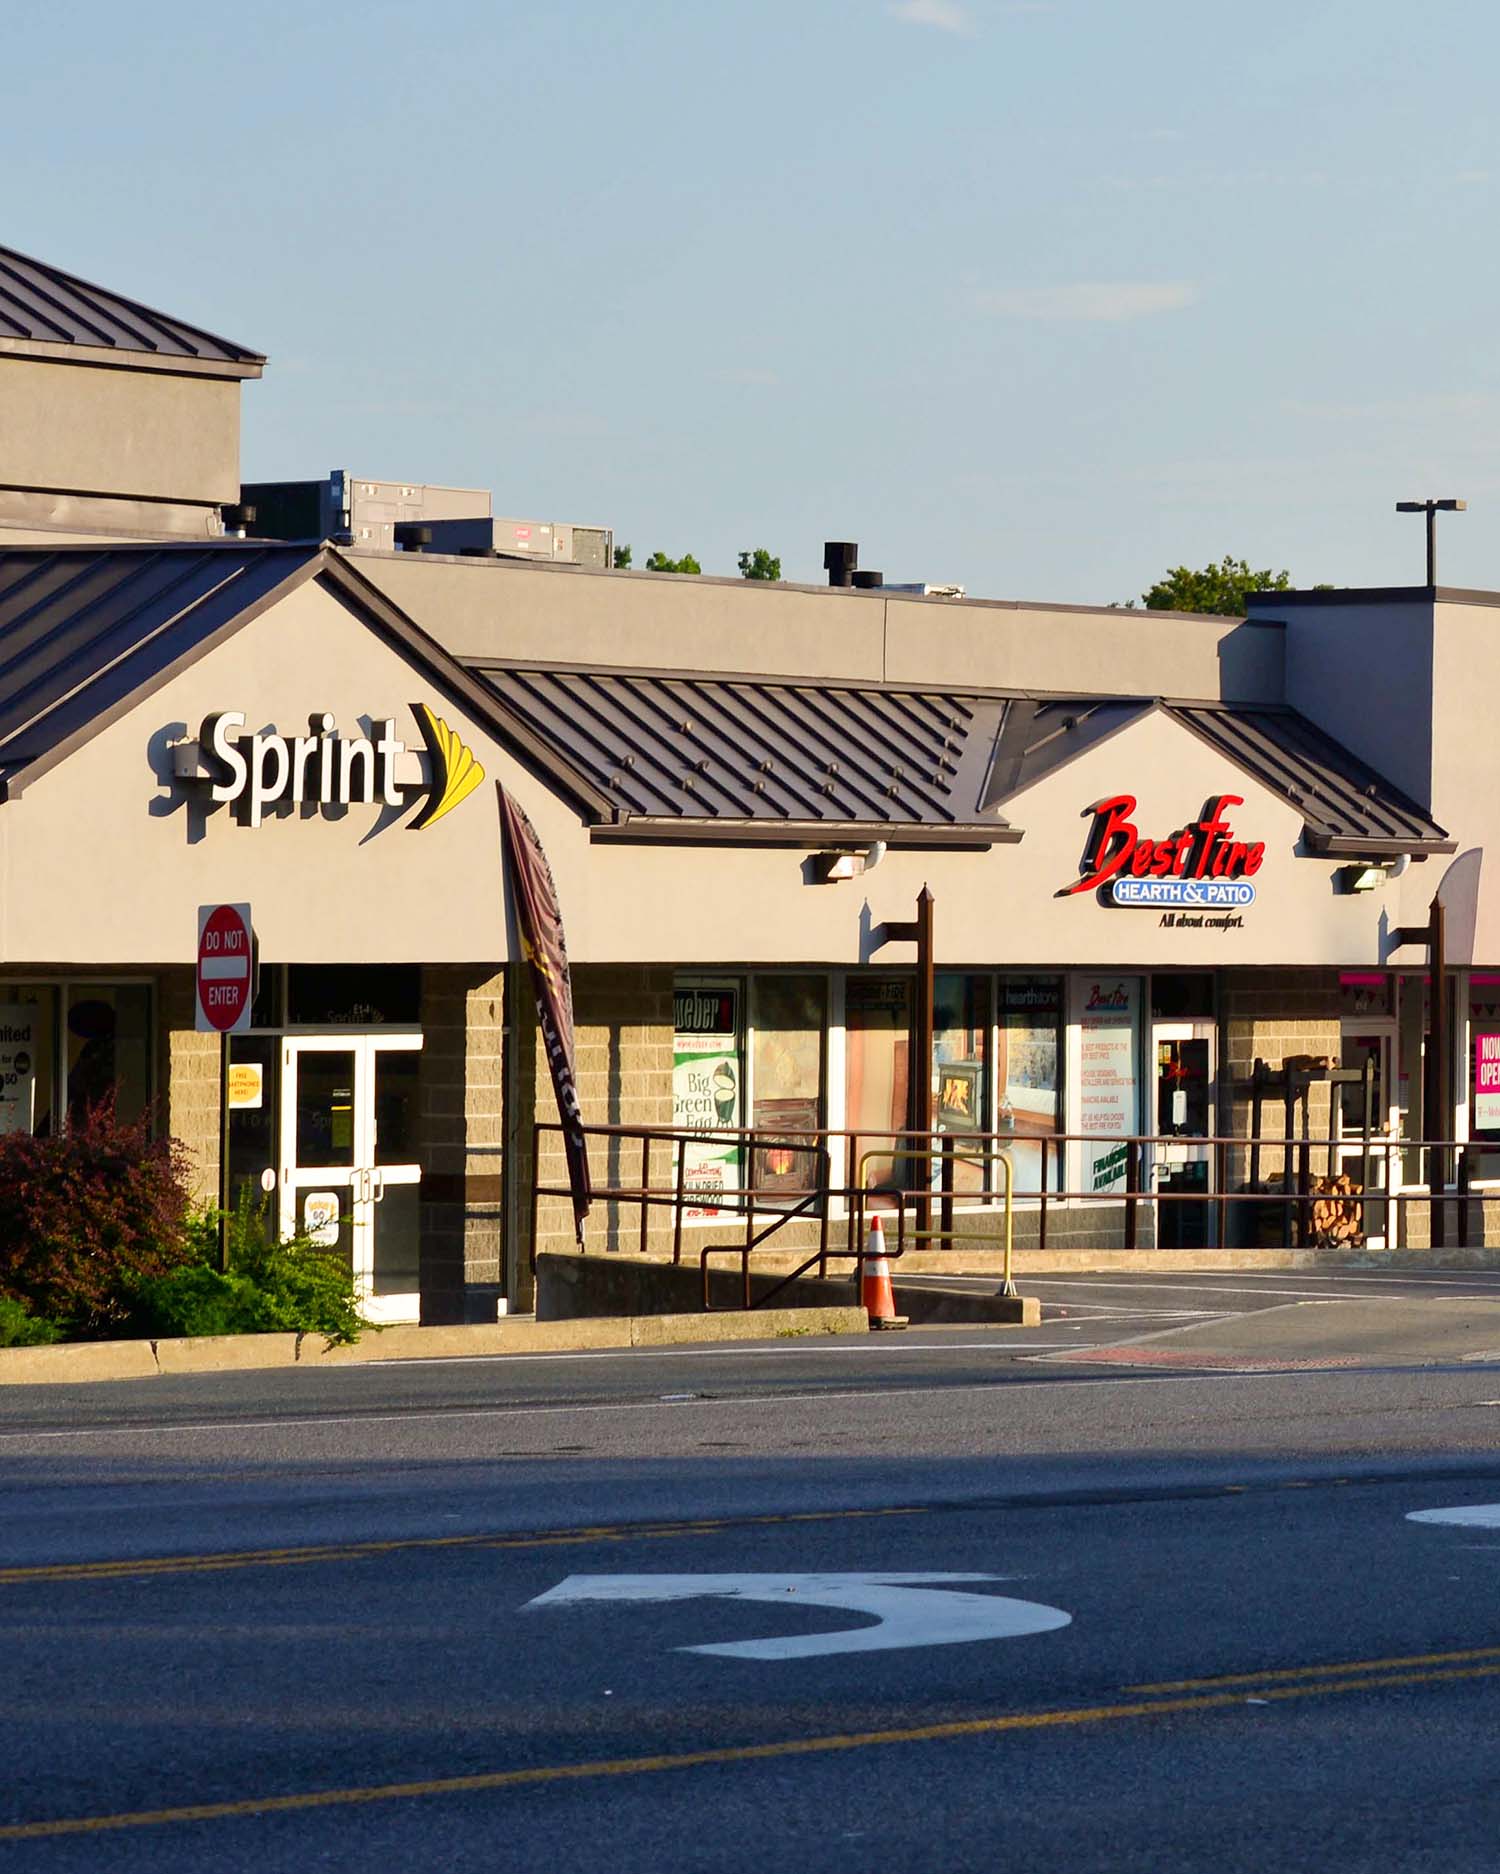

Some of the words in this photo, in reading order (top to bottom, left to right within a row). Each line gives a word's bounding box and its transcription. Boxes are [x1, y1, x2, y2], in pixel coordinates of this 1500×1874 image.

[211, 711, 404, 828] Sprint
[1070, 794, 1194, 894] Best
[1118, 883, 1179, 900] HEARTH
[1183, 883, 1204, 903] &
[1207, 885, 1251, 902] PATIO
[1159, 913, 1175, 927] All
[1176, 913, 1202, 928] about
[1204, 914, 1244, 932] comfort.
[206, 931, 219, 950] DO
[224, 930, 243, 949] NOT
[208, 986, 239, 1005] ENTER
[688, 1073, 711, 1096] Big
[687, 1115, 712, 1138] Egg
